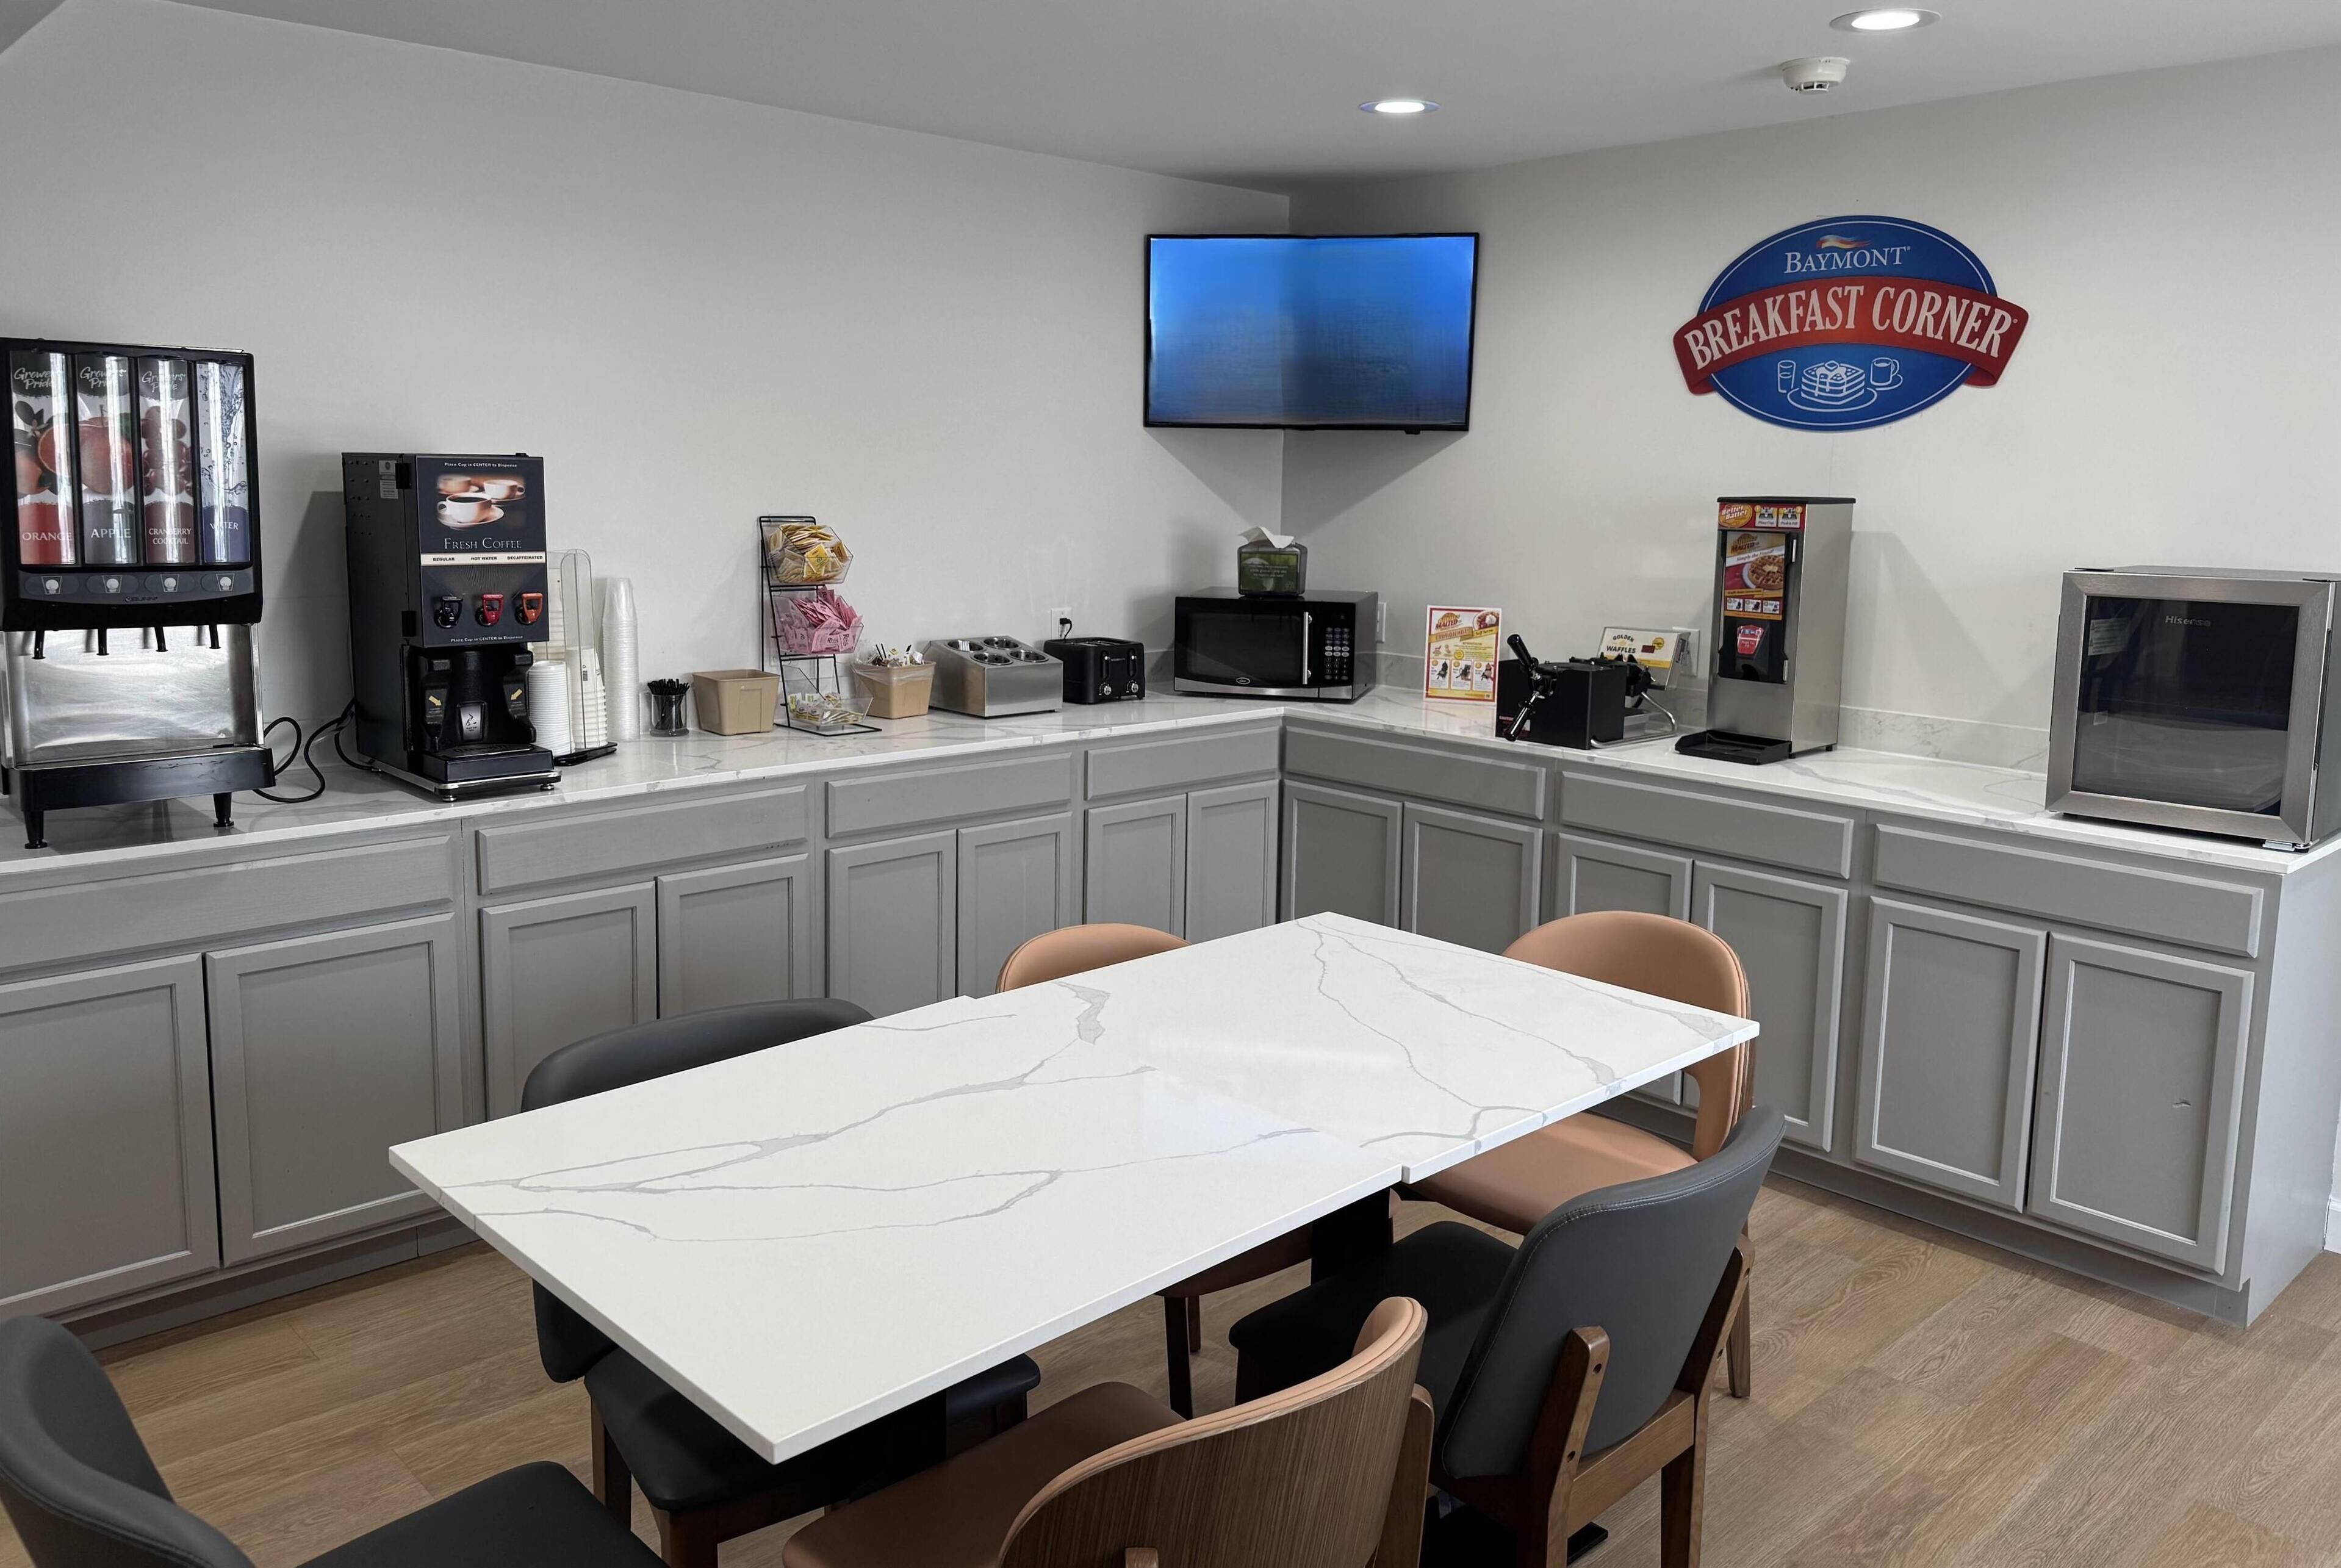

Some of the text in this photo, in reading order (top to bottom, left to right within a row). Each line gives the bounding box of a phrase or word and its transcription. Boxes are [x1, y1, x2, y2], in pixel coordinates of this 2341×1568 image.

[1784, 246, 1907, 274] BAYMONT
[1685, 286, 2013, 371] BREAKFAST CORNER
[210, 522, 239, 530] WTER
[22, 531, 73, 541] ORANGE
[91, 528, 132, 539] APPLE
[444, 538, 477, 549] FRESH
[1613, 634, 1635, 642] GOLDEN
[1606, 645, 1636, 654] WAFFLES
